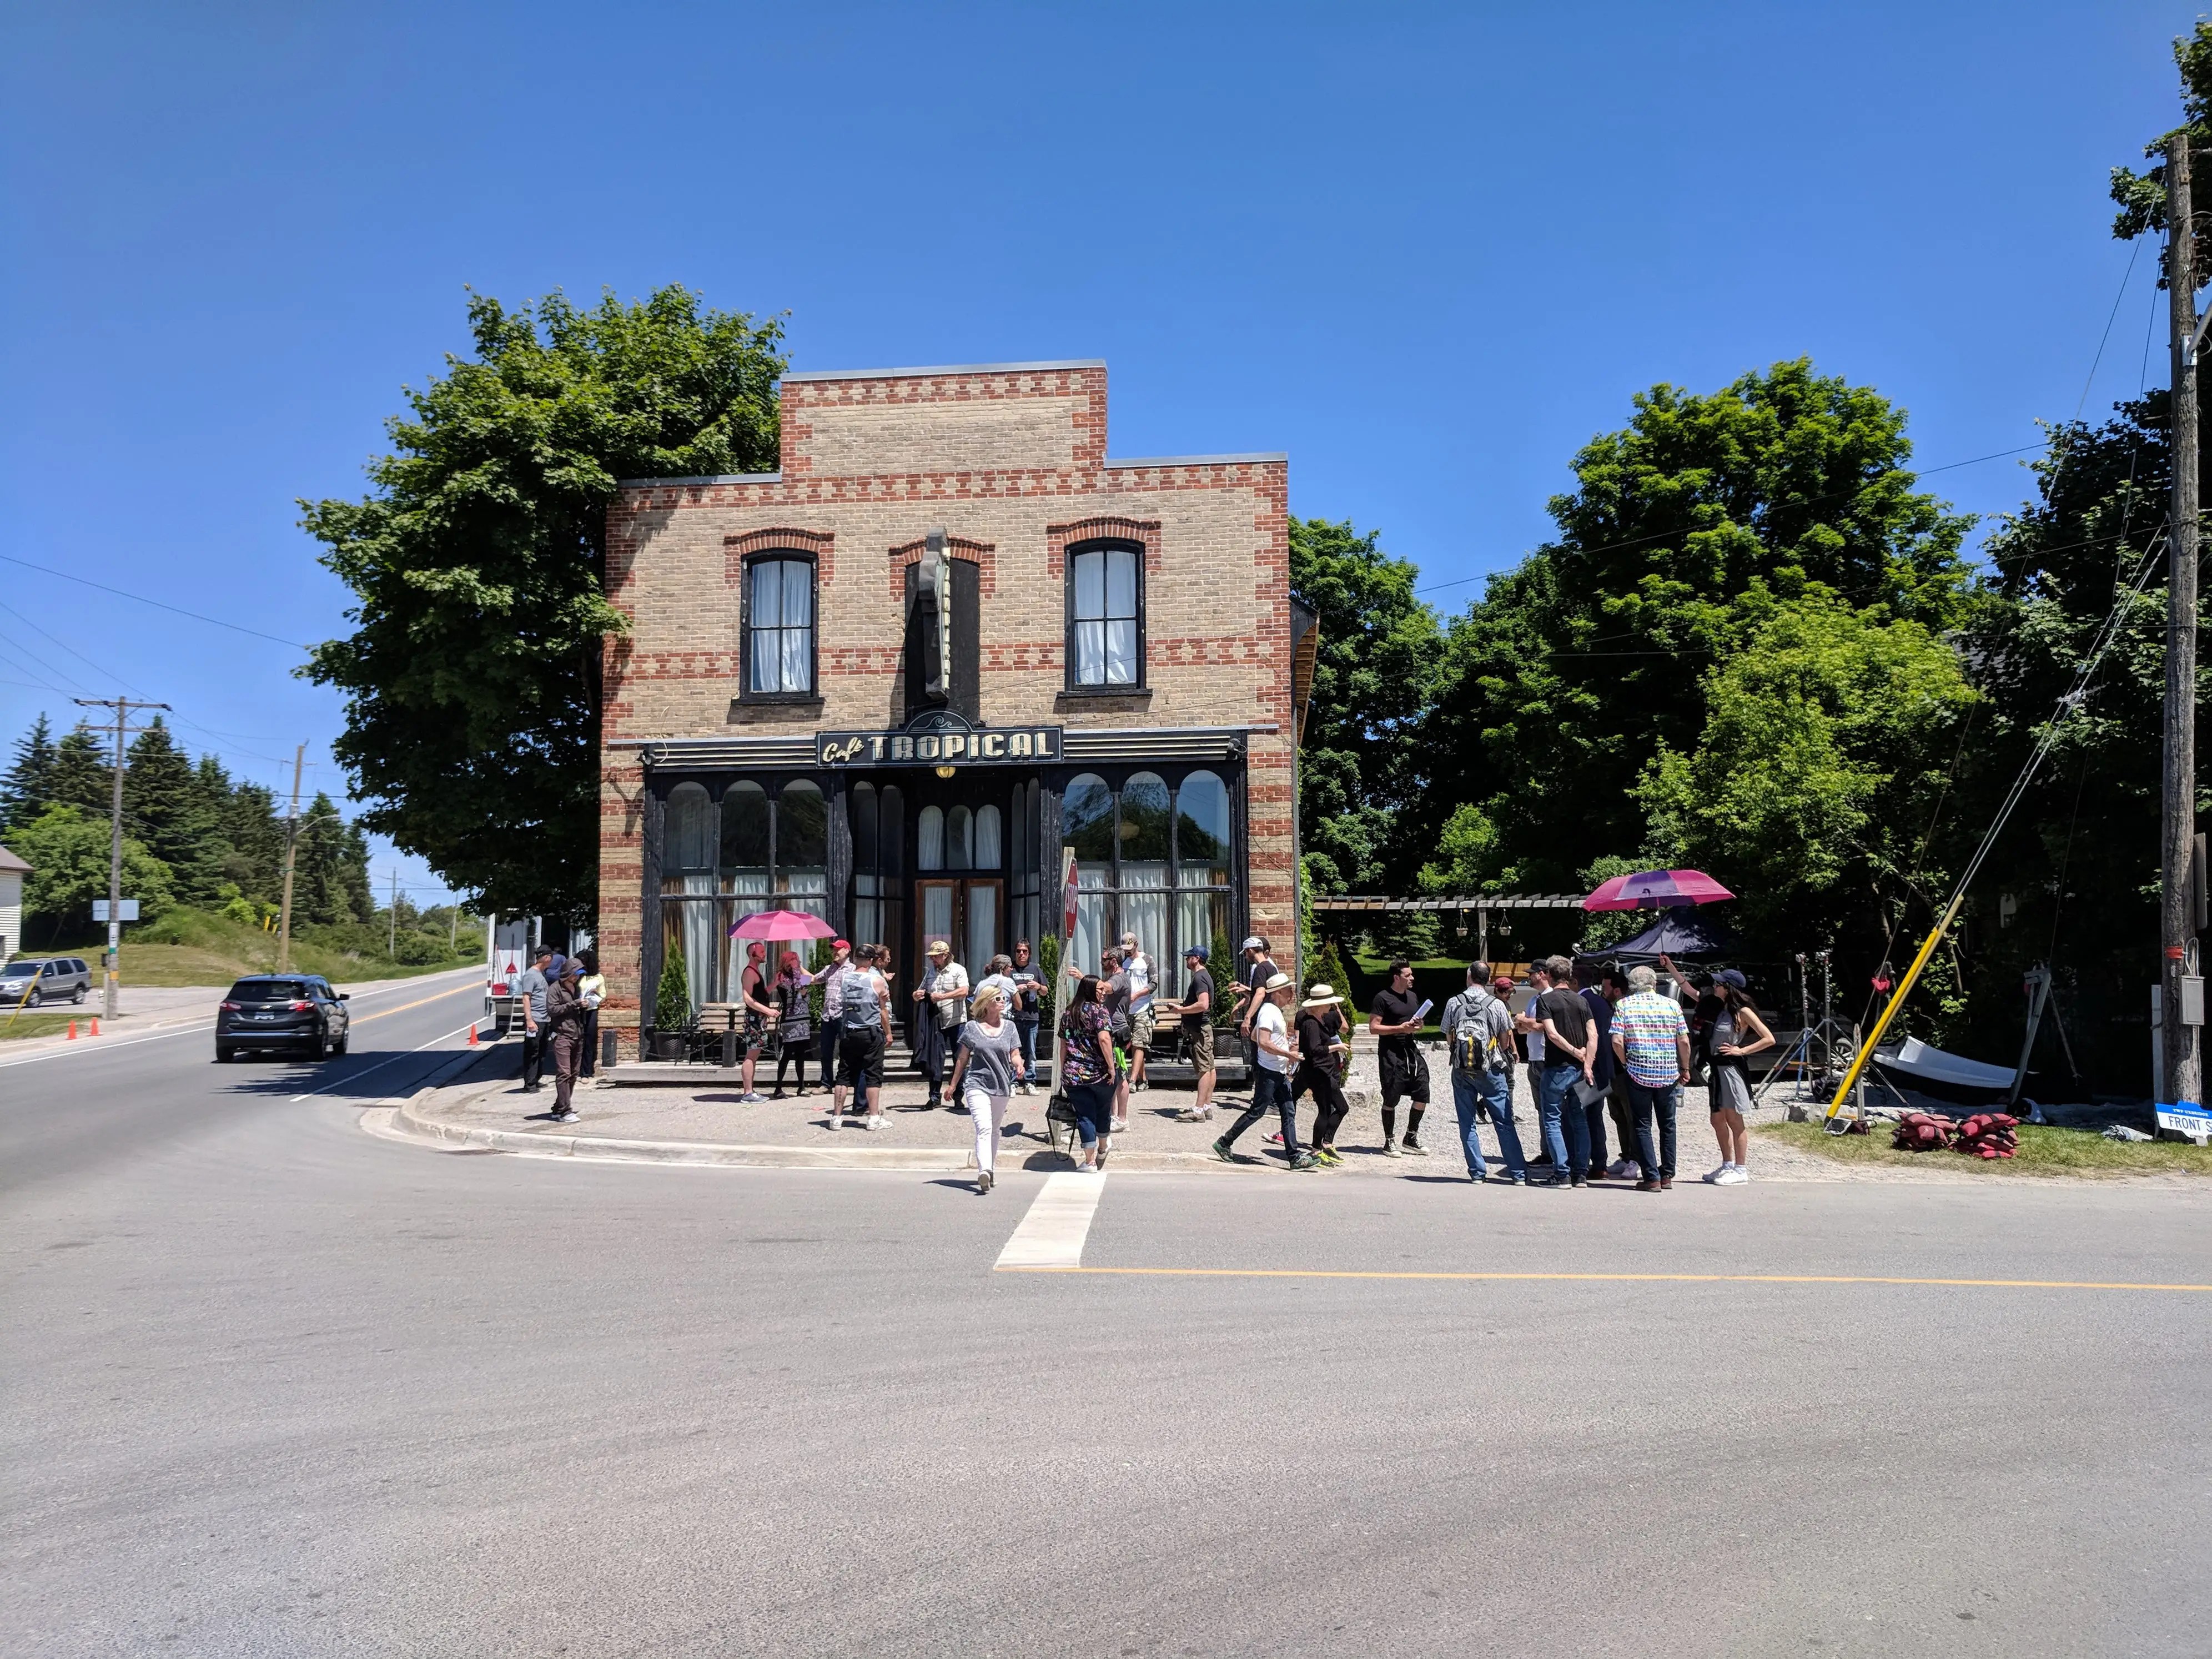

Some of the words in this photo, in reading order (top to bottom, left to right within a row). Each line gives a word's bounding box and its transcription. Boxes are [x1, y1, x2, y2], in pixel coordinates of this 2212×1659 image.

[868, 732, 1054, 761] TROPICAL
[1067, 882, 1078, 914] STOP
[2168, 1115, 2200, 1131] FRONT
